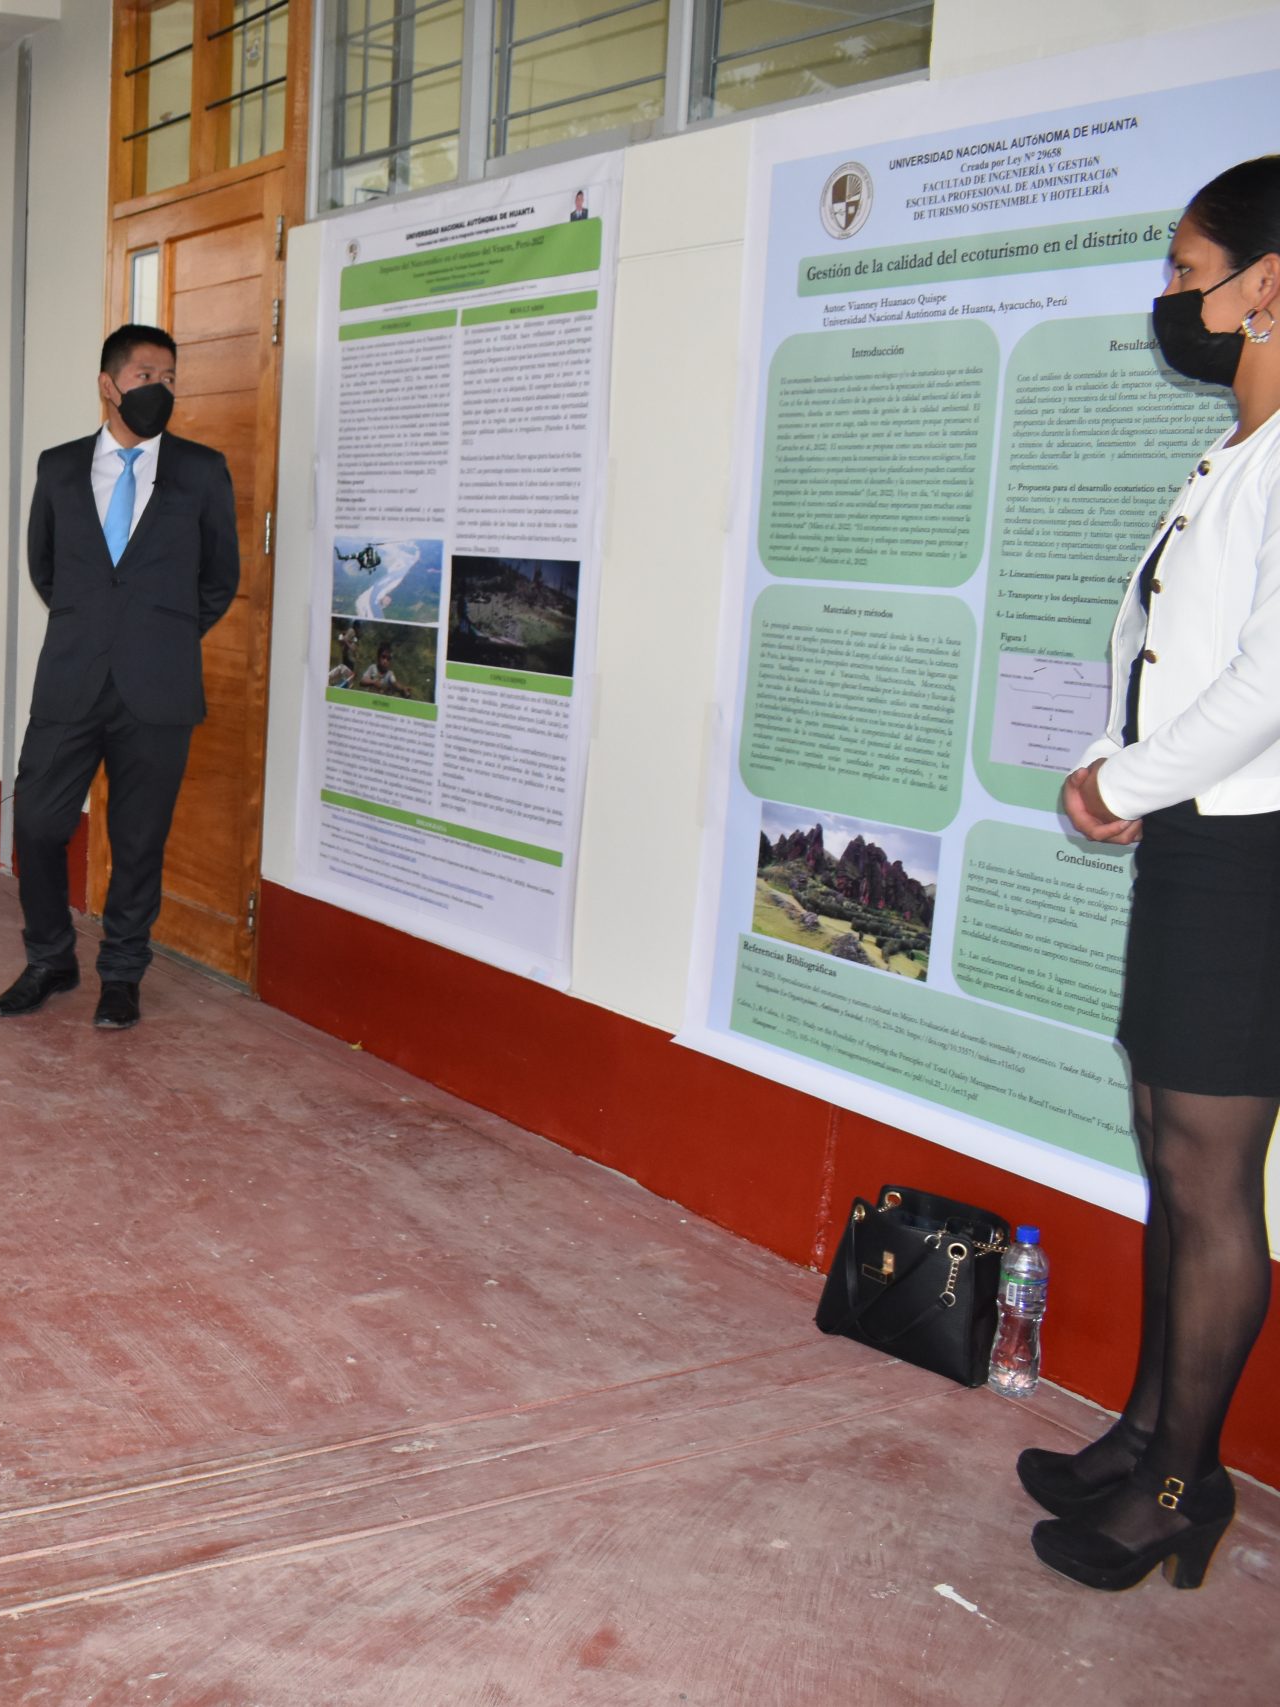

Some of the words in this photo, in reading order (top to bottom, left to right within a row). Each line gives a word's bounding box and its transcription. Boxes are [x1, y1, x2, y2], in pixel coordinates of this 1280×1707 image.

[889, 149, 953, 169] UNIVERSIDAD
[955, 140, 1008, 157] NACIONAL
[1072, 125, 1088, 138] DE
[1091, 117, 1138, 134] HUANTA
[960, 160, 989, 172] Creada
[990, 159, 1005, 170] por
[1007, 155, 1021, 167] Ley
[1036, 147, 1061, 160] 29658
[922, 176, 971, 192] FACULTAD
[973, 173, 985, 184] DE
[988, 163, 1045, 182] INGENIERÍA
[1047, 162, 1054, 172] Y
[906, 194, 946, 208] ESCUELA
[947, 184, 1012, 201] PROFESIONAL
[1014, 181, 1028, 192] DE
[913, 210, 925, 220] DE
[927, 204, 969, 218] TURISMO
[1040, 192, 1048, 202] Y
[1049, 184, 1109, 200] HOTELERÍA
[498, 212, 507, 220] DE
[508, 207, 534, 217] HUANTA
[806, 263, 850, 280] Gestión
[853, 260, 869, 275] de
[871, 258, 884, 273] la
[886, 252, 932, 271] calidad
[936, 248, 957, 265] del
[960, 244, 1038, 262] ecoturismo
[1043, 241, 1061, 253] en
[1064, 233, 1078, 250] el
[1082, 229, 1138, 248] distrito
[1142, 224, 1162, 241] de
[822, 314, 866, 326] Universidad
[868, 310, 903, 322] Nacional
[904, 309, 946, 319] Autónoma
[948, 305, 958, 315] de
[961, 304, 996, 314] Huanta,
[998, 298, 1044, 313] Ayacucho,
[1046, 296, 1067, 307] Perú
[847, 301, 878, 311] Vianney
[880, 298, 915, 307] Huanaco
[917, 294, 947, 305] Quispe
[851, 345, 904, 358] Introducción
[1077, 484, 1111, 492] desarrollo
[1007, 590, 1042, 600] Transporte
[822, 604, 856, 614] Materiales
[857, 609, 861, 617] y
[863, 609, 893, 618] métodos
[1005, 610, 1014, 618] La
[1056, 616, 1091, 624] ambiental
[1000, 632, 1022, 642] Figura
[1056, 850, 1123, 873] Conclusiones
[743, 940, 784, 960] Referencias
[785, 953, 837, 976] Bibliográficas
